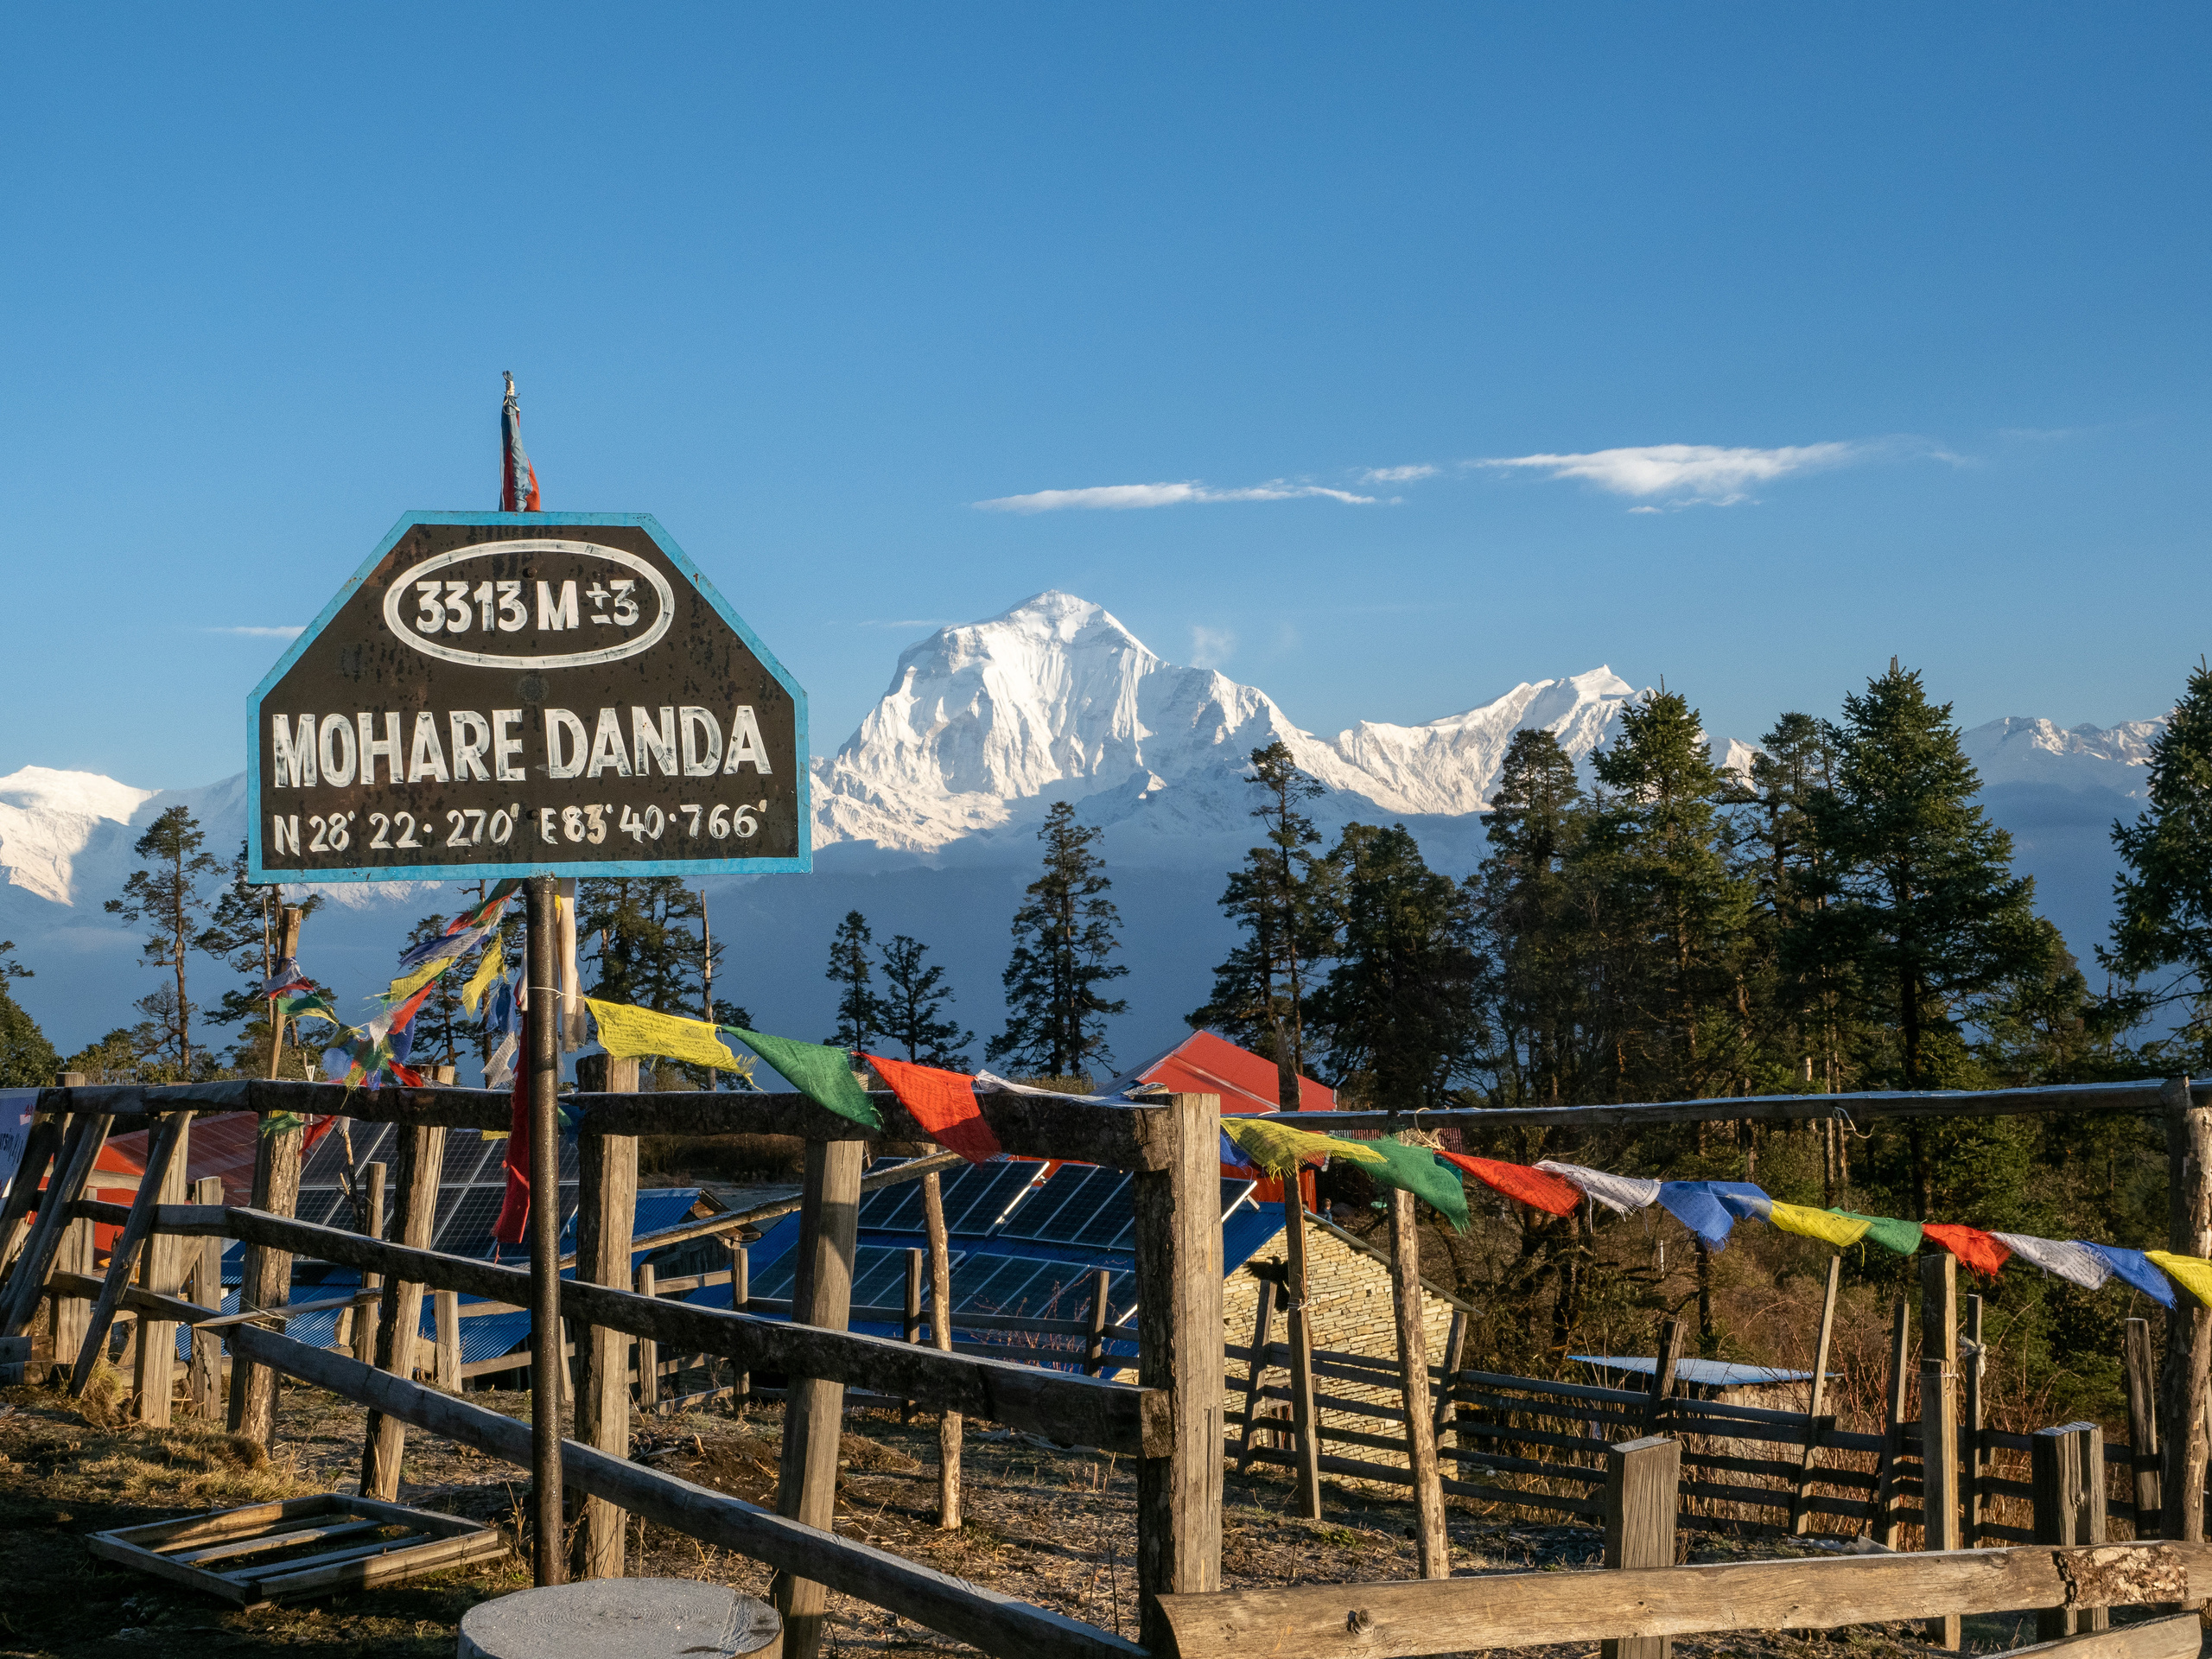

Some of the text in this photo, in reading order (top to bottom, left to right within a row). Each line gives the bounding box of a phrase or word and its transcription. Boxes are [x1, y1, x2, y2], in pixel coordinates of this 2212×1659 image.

[416, 581, 527, 633] 3313
[537, 581, 579, 631] M
[273, 705, 772, 788] MOHARE DANDA
